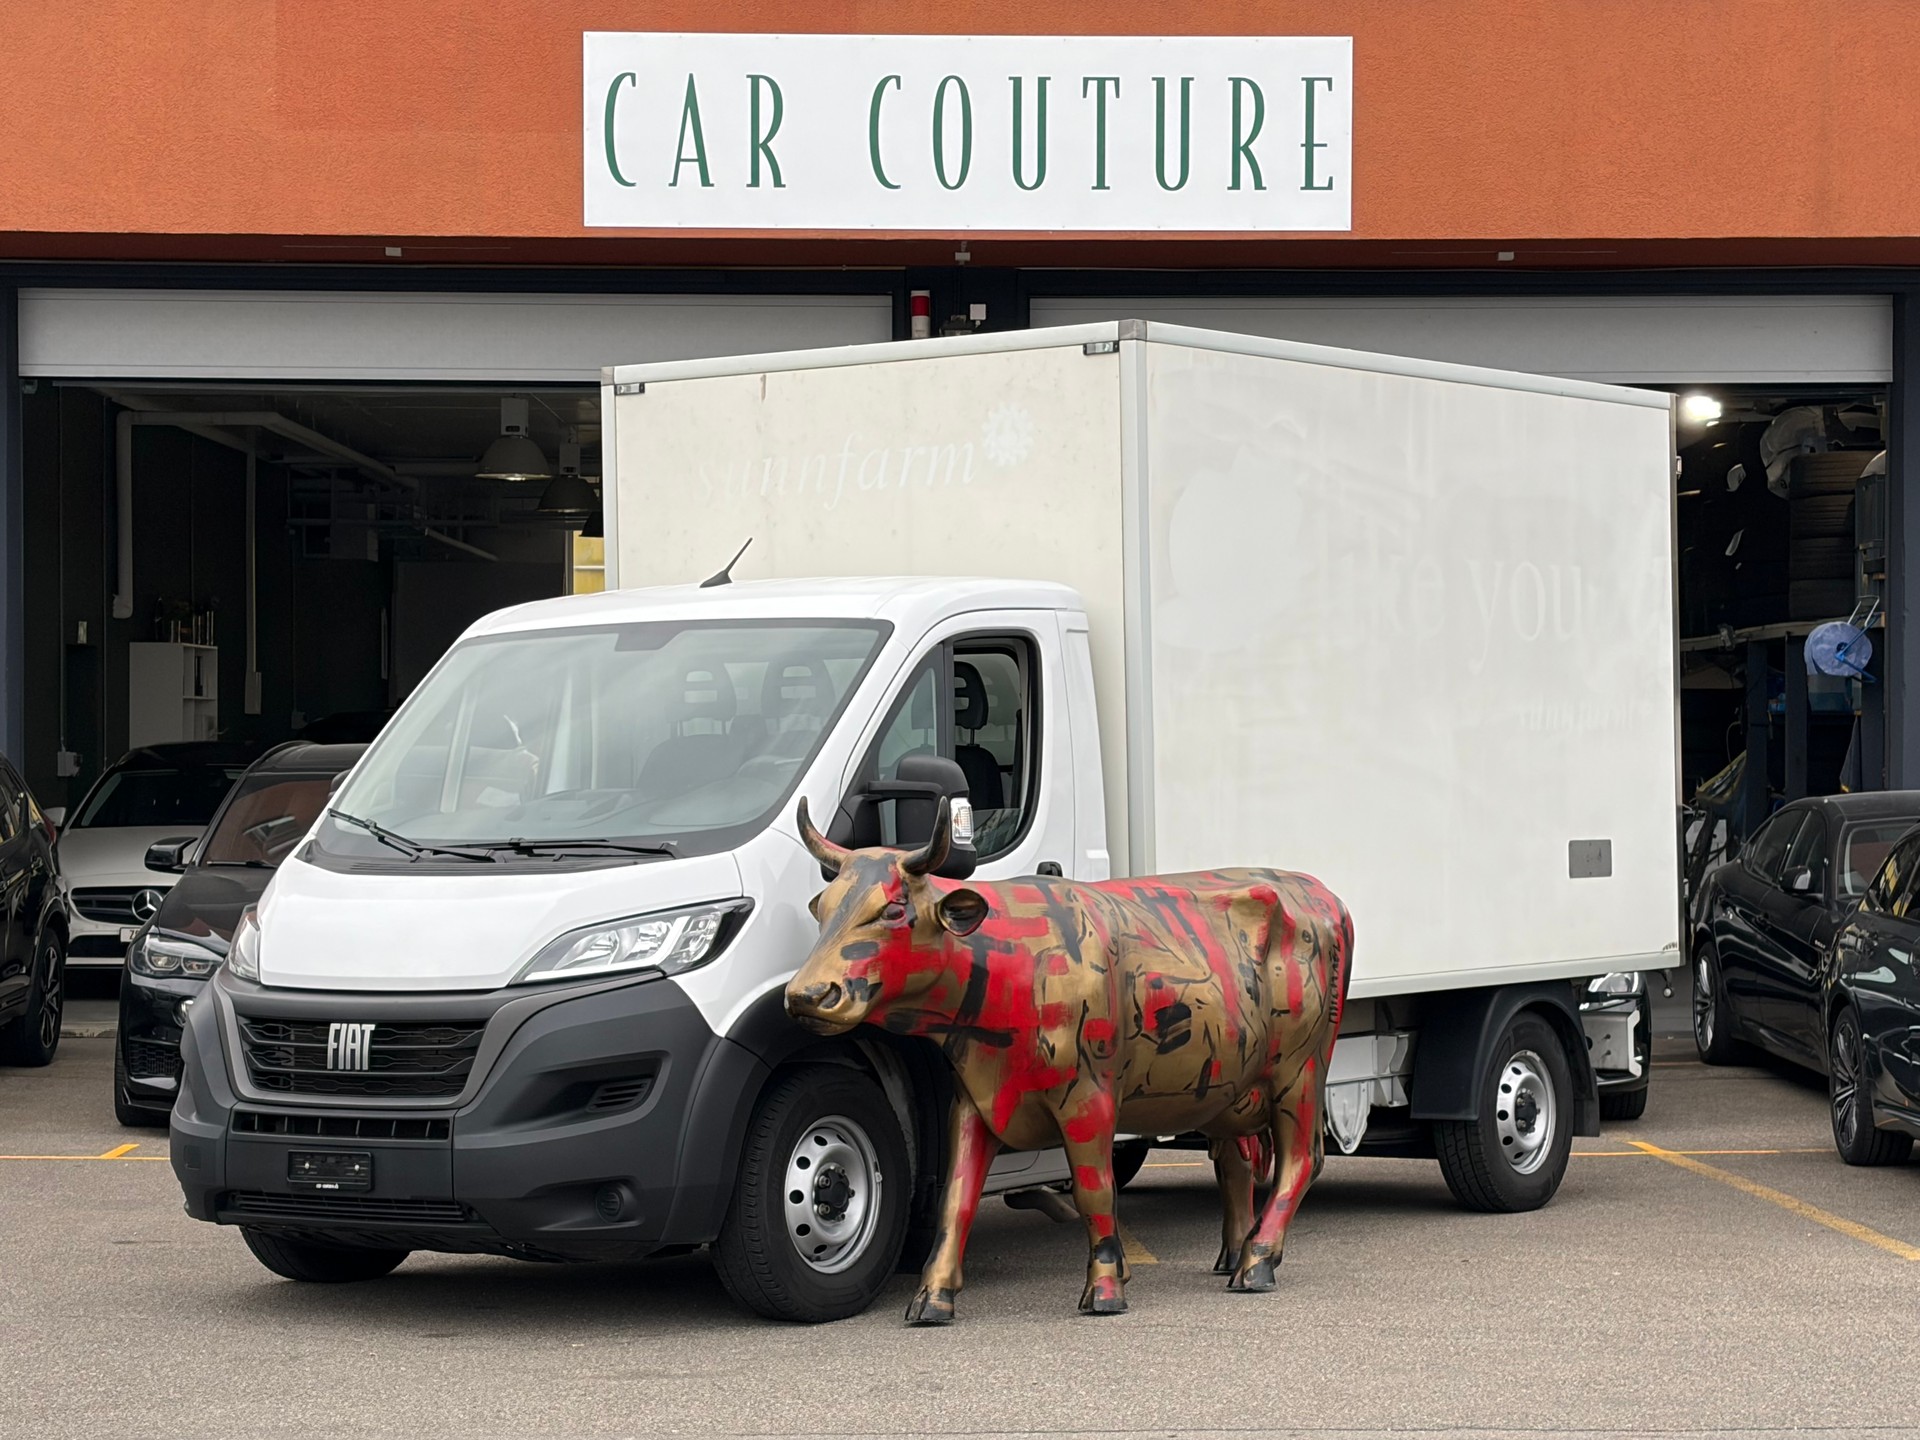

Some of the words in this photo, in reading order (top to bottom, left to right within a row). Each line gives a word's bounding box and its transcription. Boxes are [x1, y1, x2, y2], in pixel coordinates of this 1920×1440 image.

[603, 72, 787, 189] CAR
[868, 74, 1335, 191] COUTURE
[694, 431, 977, 511] sunnfarm
[326, 1022, 376, 1071] FIAT
